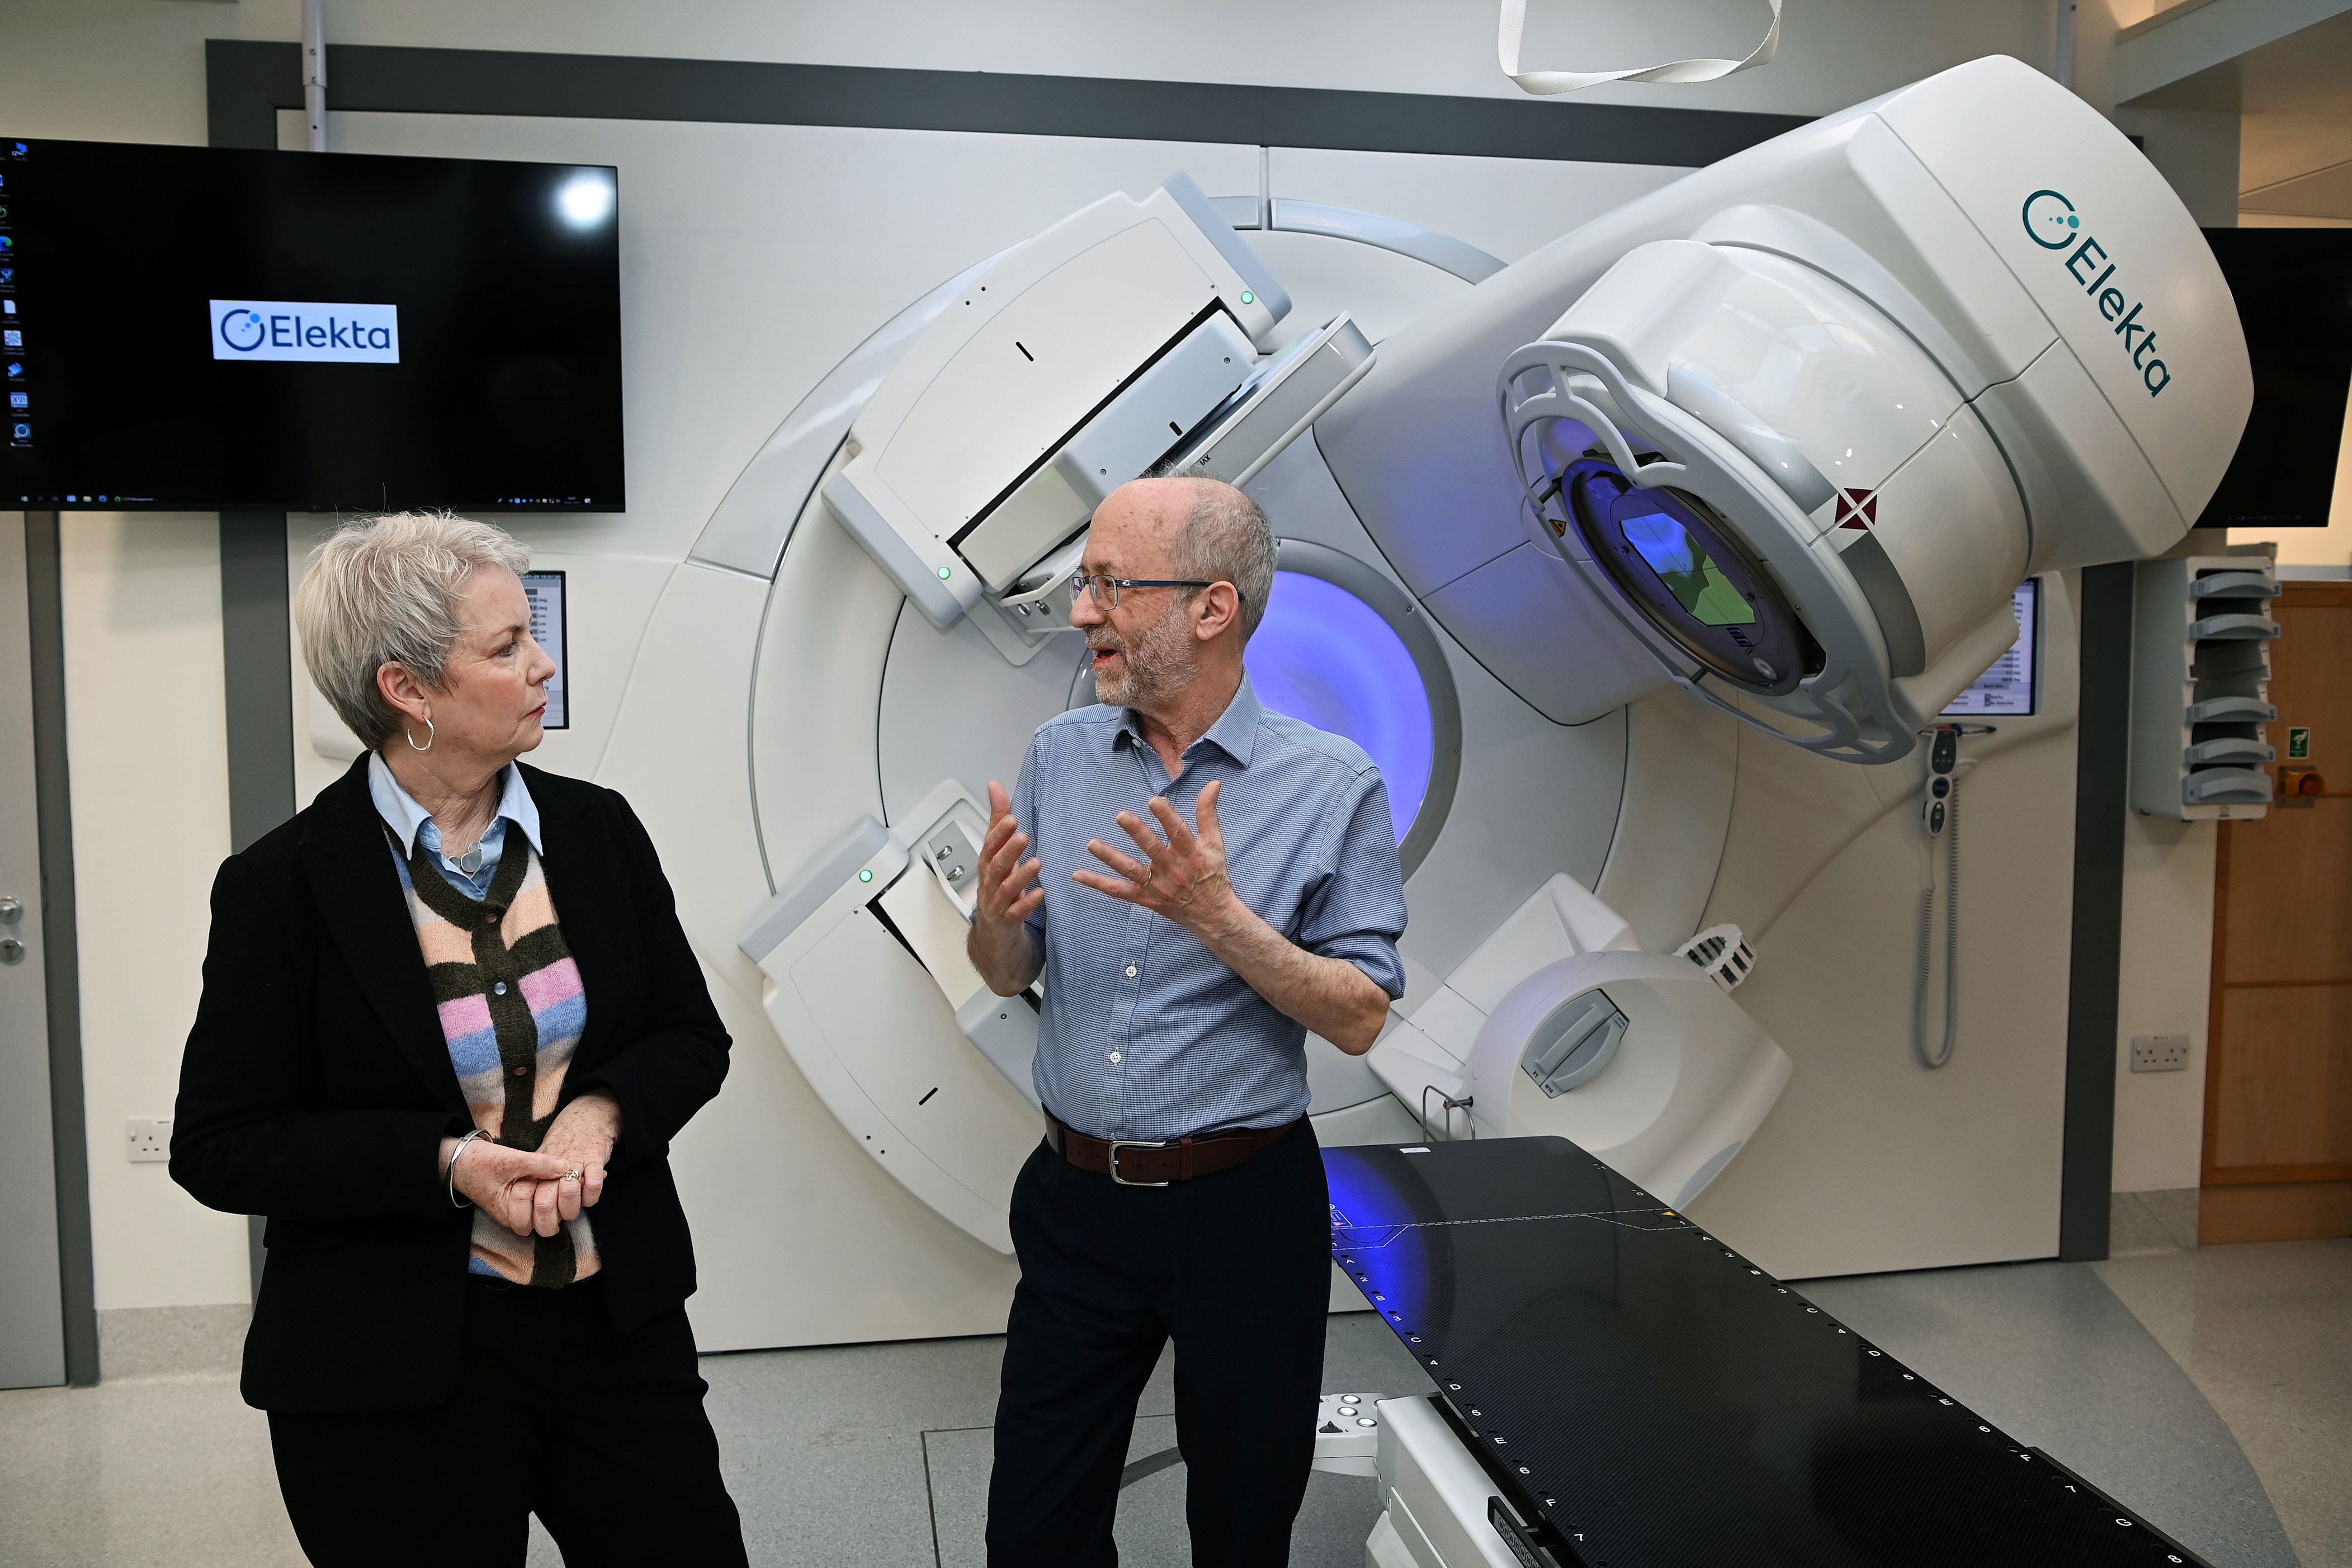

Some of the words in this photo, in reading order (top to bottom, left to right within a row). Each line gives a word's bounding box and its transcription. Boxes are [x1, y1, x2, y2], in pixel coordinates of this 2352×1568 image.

[2065, 236, 2171, 398] Elekta
[270, 315, 391, 349] Elekta
[1199, 454, 1211, 466] XVI
[1545, 1084, 1553, 1093] M10
[2115, 1518, 2132, 1527] G
[1574, 1533, 1583, 1542] 7
[2167, 1555, 2182, 1563] 8
